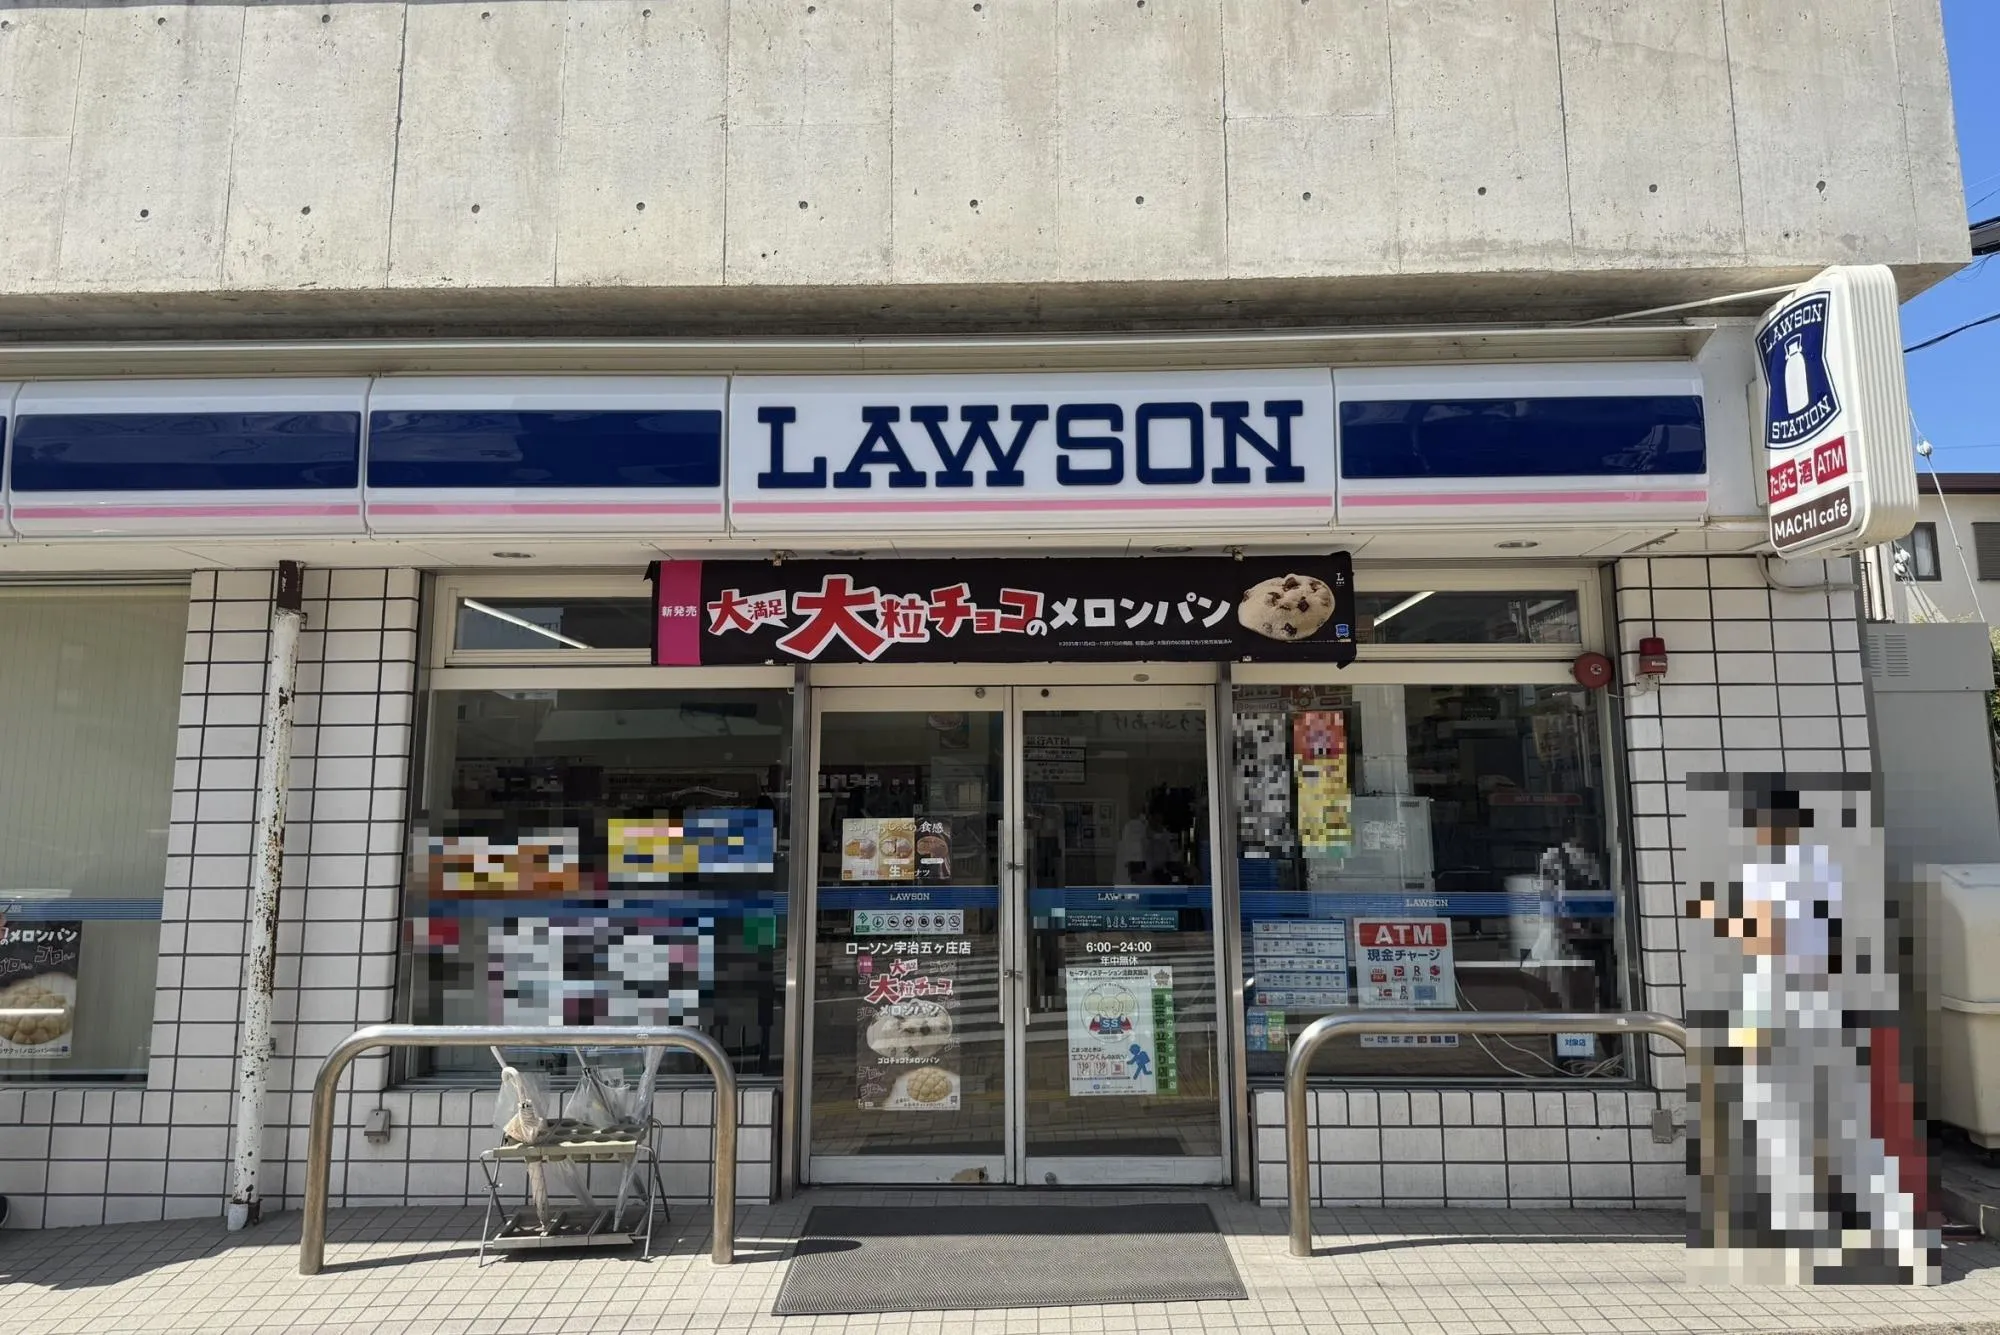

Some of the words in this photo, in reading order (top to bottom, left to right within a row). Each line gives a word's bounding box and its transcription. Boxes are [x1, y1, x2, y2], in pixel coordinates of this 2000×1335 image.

[1763, 303, 1823, 354] LAWSON
[1771, 396, 1831, 439] STATION
[758, 400, 1304, 488] LAWSON
[1770, 466, 1796, 496] たばこ
[1816, 445, 1844, 474] ATM
[1774, 509, 1816, 541] MACHI
[1819, 497, 1848, 525] café
[661, 604, 698, 619] 新発売
[707, 588, 788, 636] 大満足
[889, 892, 930, 901] LAWSON
[1405, 898, 1449, 907] LAWSON
[1374, 924, 1433, 944] ATM
[845, 941, 972, 955] ローソン宇治五ヶ庄店
[1367, 948, 1441, 962] 現金チャージ
[1101, 956, 1139, 966] 年中無休
